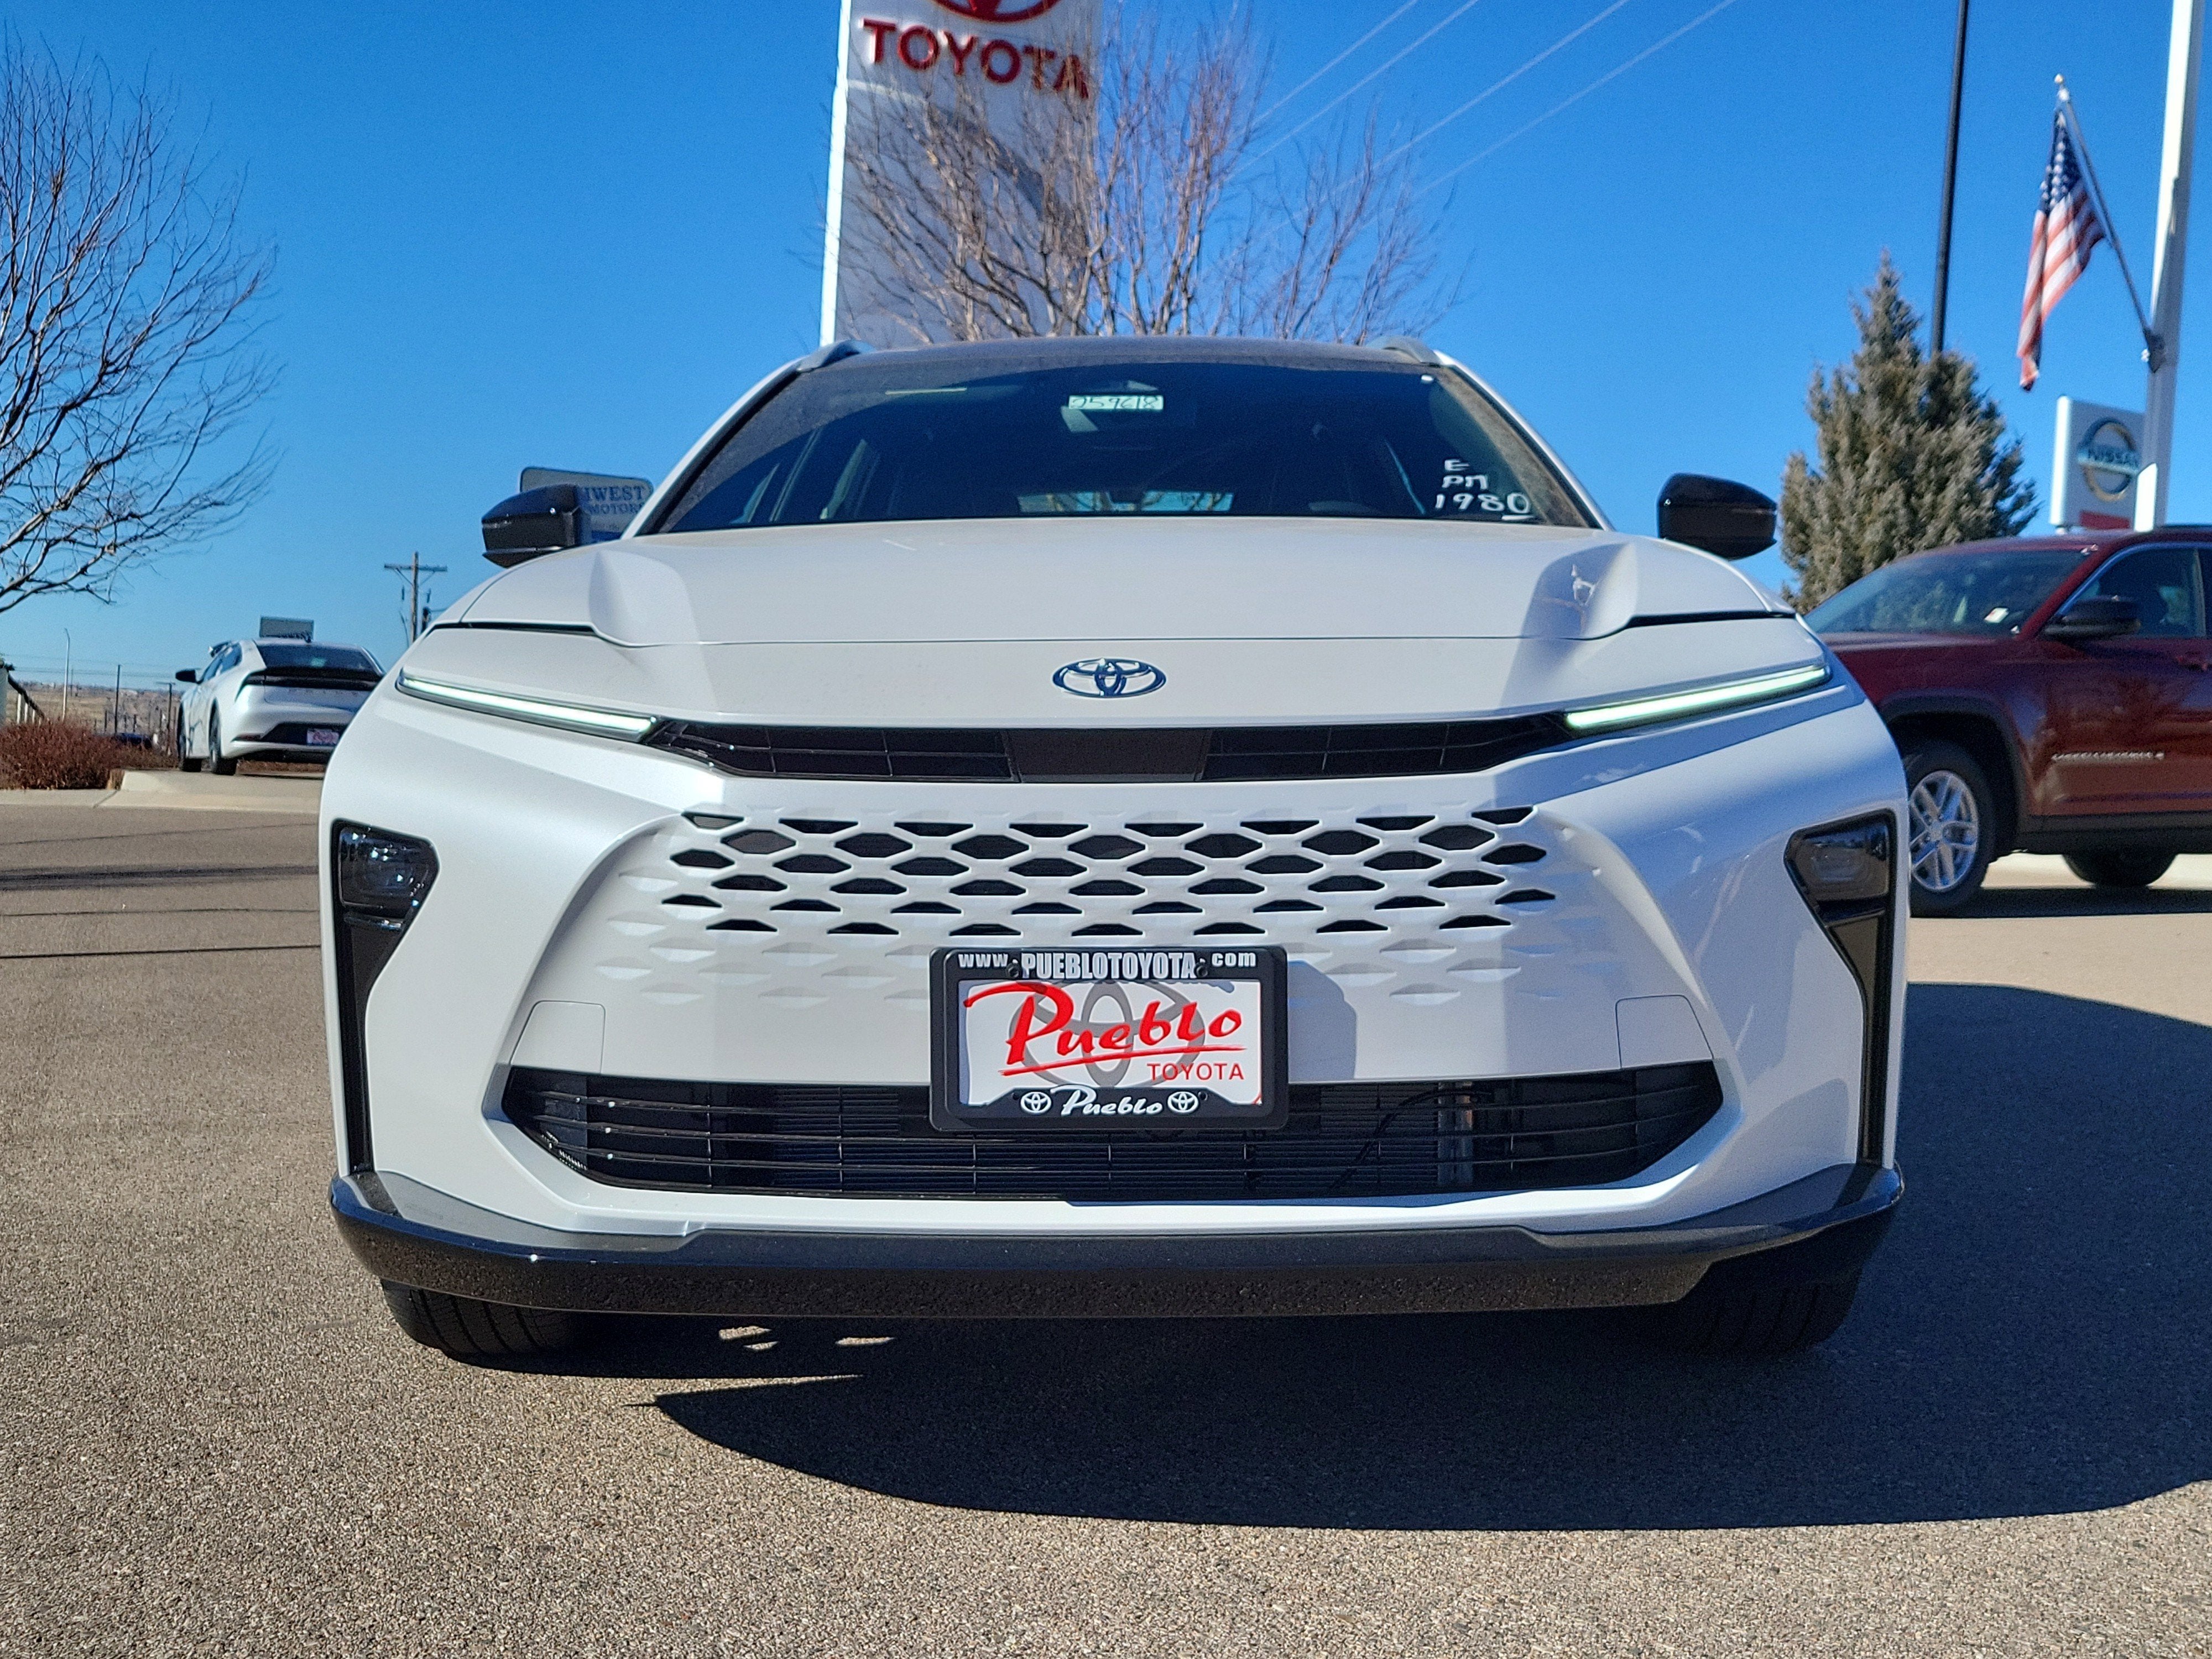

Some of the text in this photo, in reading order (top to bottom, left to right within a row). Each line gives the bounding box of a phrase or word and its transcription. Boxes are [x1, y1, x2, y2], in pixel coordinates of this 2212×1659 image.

[860, 18, 1089, 99] TOYOTA
[1435, 492, 1531, 514] 1980
[963, 981, 1243, 1065] Pueblo
[1147, 1062, 1244, 1080] TOYOTA
[1050, 1084, 1164, 1116] Pueblo
